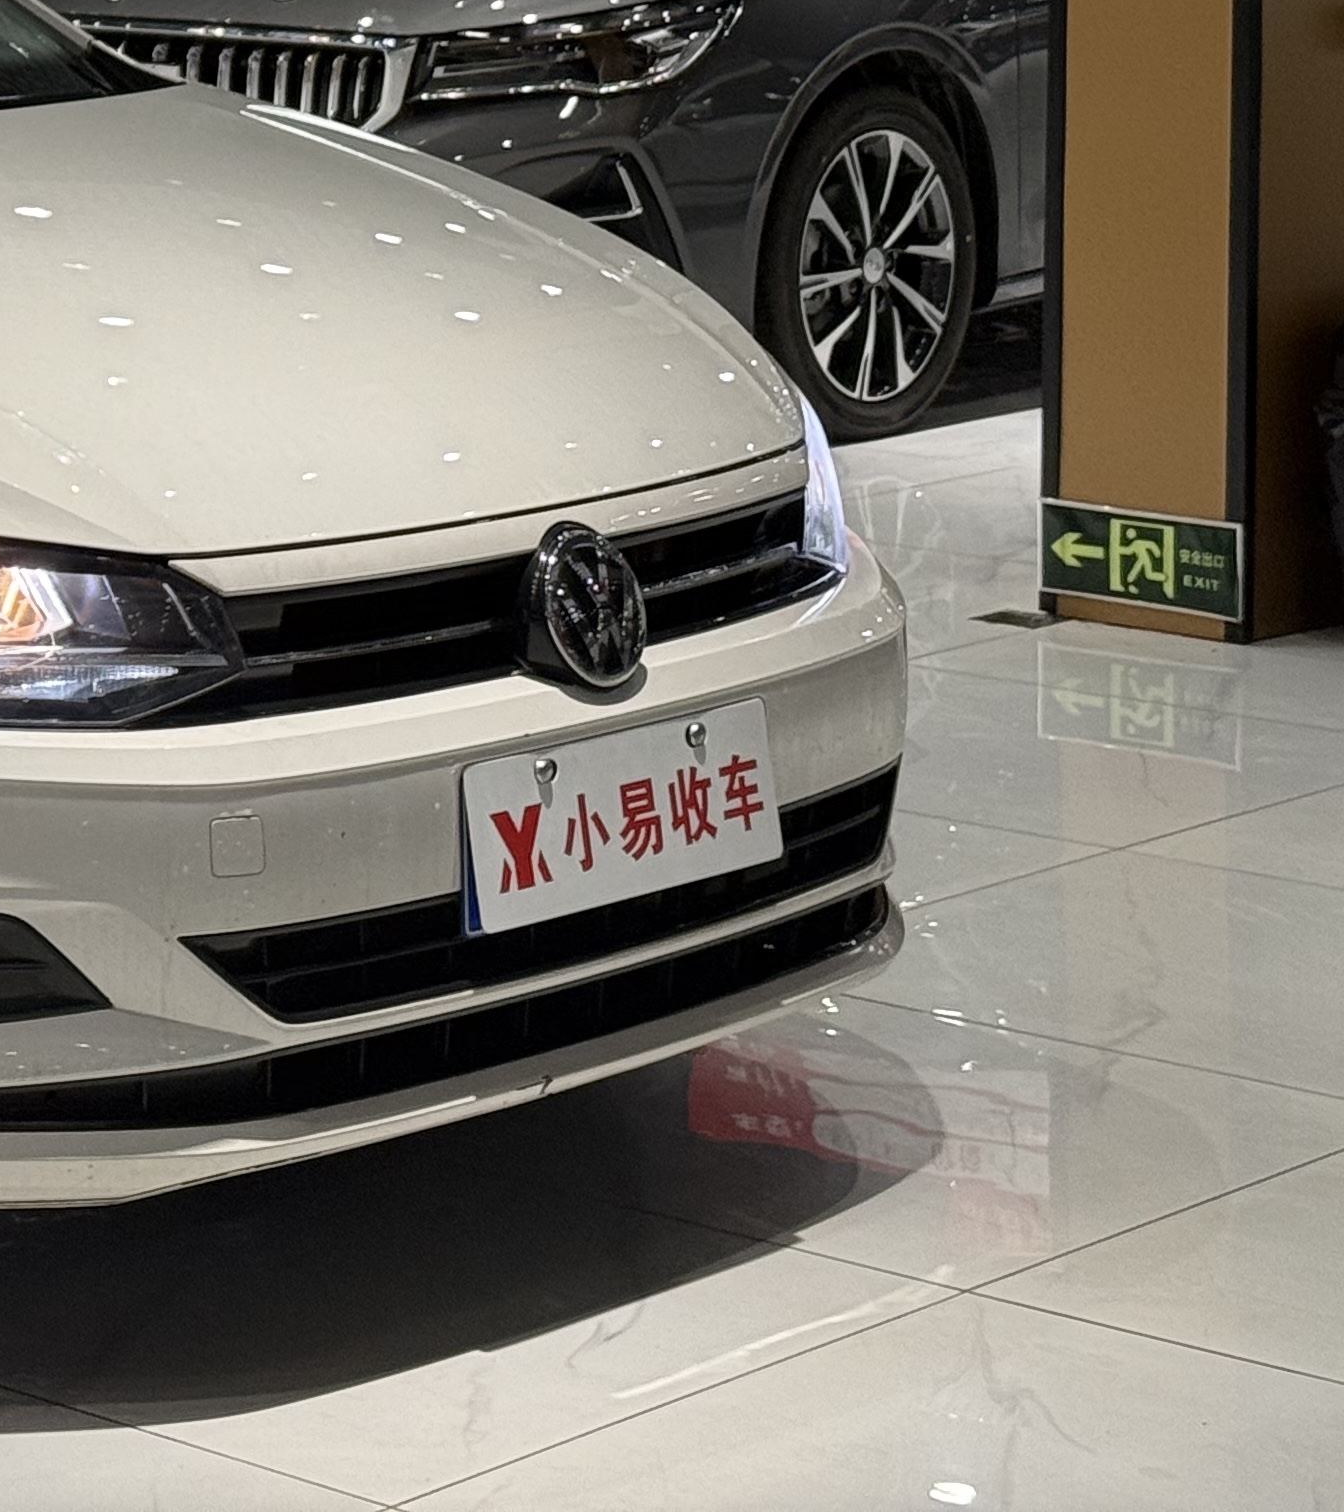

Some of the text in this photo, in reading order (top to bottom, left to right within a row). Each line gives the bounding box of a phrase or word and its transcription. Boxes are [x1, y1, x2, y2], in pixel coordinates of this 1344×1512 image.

[1179, 548, 1226, 569] 安全出口
[1183, 575, 1221, 591] EXIT
[563, 754, 765, 872] 小易收车
